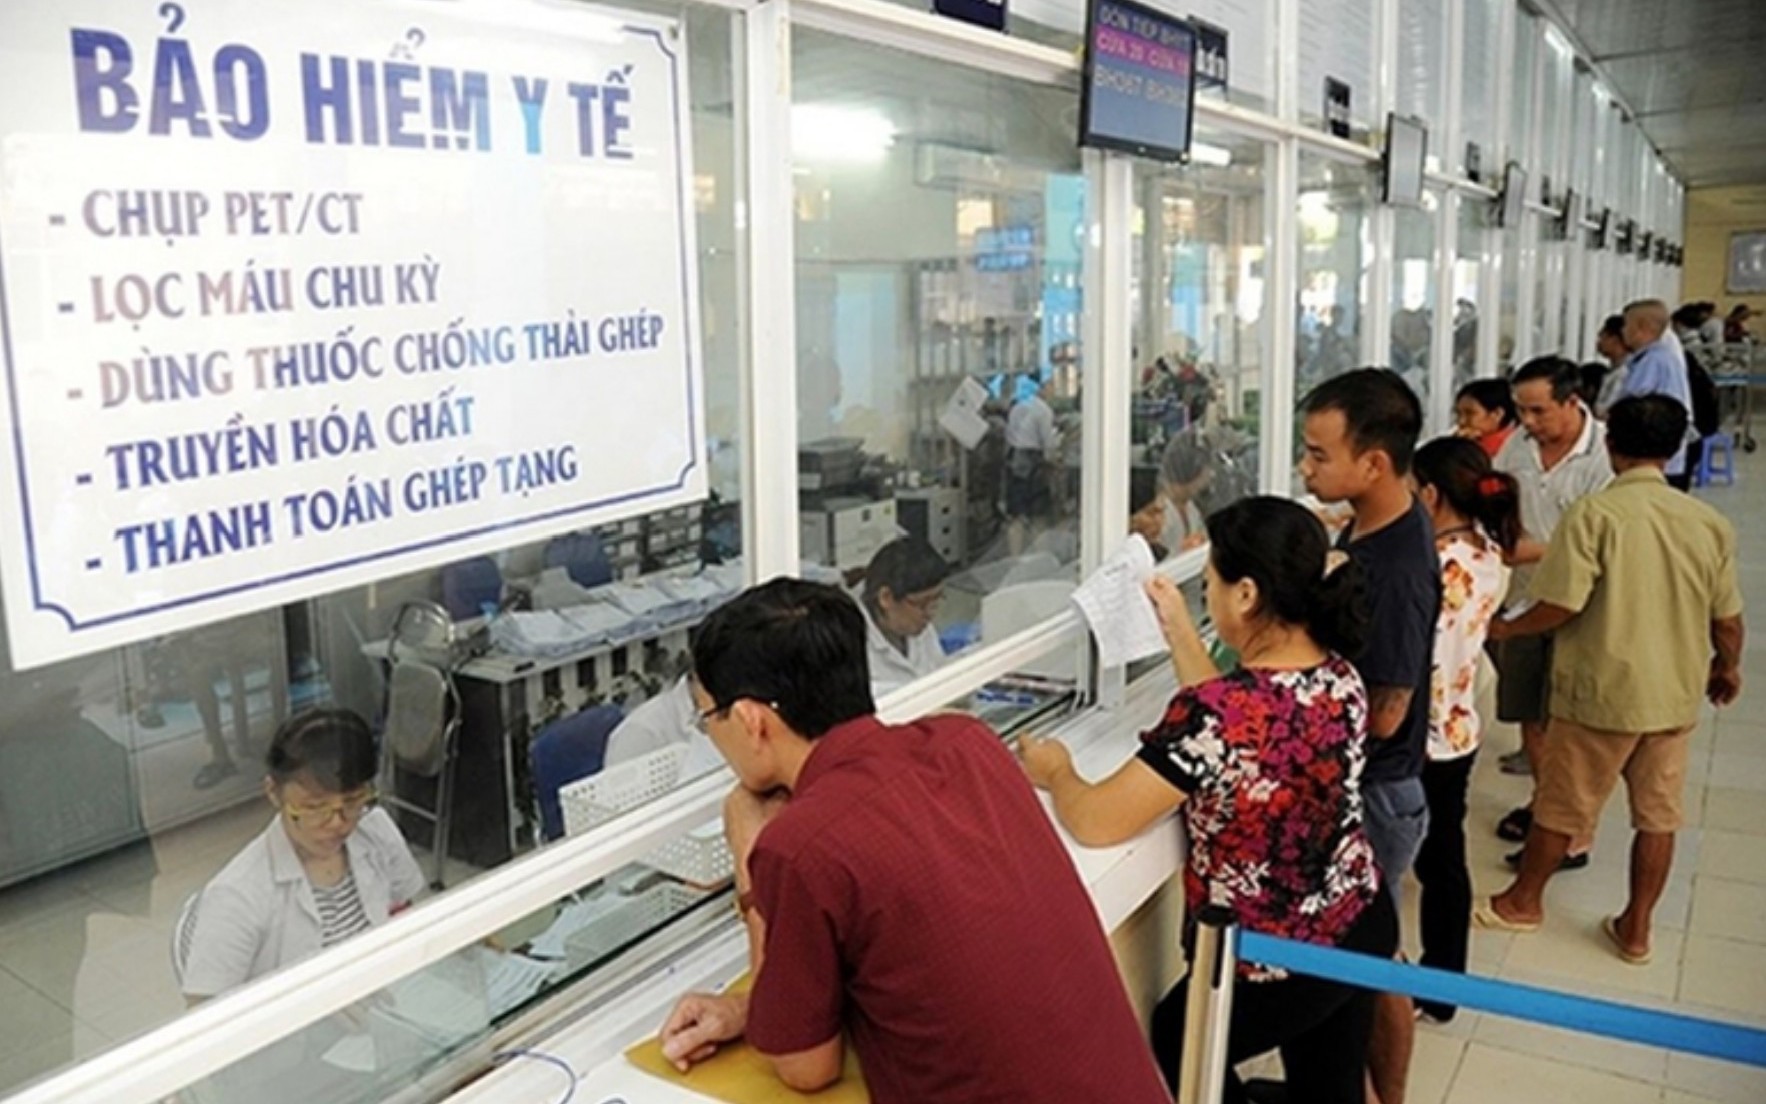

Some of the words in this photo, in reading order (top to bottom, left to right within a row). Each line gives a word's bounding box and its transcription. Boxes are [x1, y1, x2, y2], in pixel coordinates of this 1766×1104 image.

[70, 2, 270, 141] BẢO
[300, 28, 492, 153] HIỂM
[511, 75, 549, 154] Y
[567, 64, 634, 159] TẾ
[82, 189, 210, 247] CHỤP
[224, 191, 364, 235] PET/CT
[90, 272, 186, 332] LỌC
[197, 259, 295, 317] MÁU
[305, 266, 384, 309] CHU
[394, 254, 441, 305] KỲ
[98, 347, 234, 408] DÙNG
[245, 326, 384, 389] THUỐC
[393, 317, 516, 375] CHỐNG
[598, 308, 664, 352] GHÉP
[105, 412, 279, 491] TRUYỀN
[290, 404, 377, 463] HÓA
[385, 385, 475, 446] CHẤT
[113, 499, 274, 574] THANH
[283, 473, 393, 538] TOÁN
[403, 455, 487, 512] GHÉP
[495, 445, 577, 497] TẠNG
